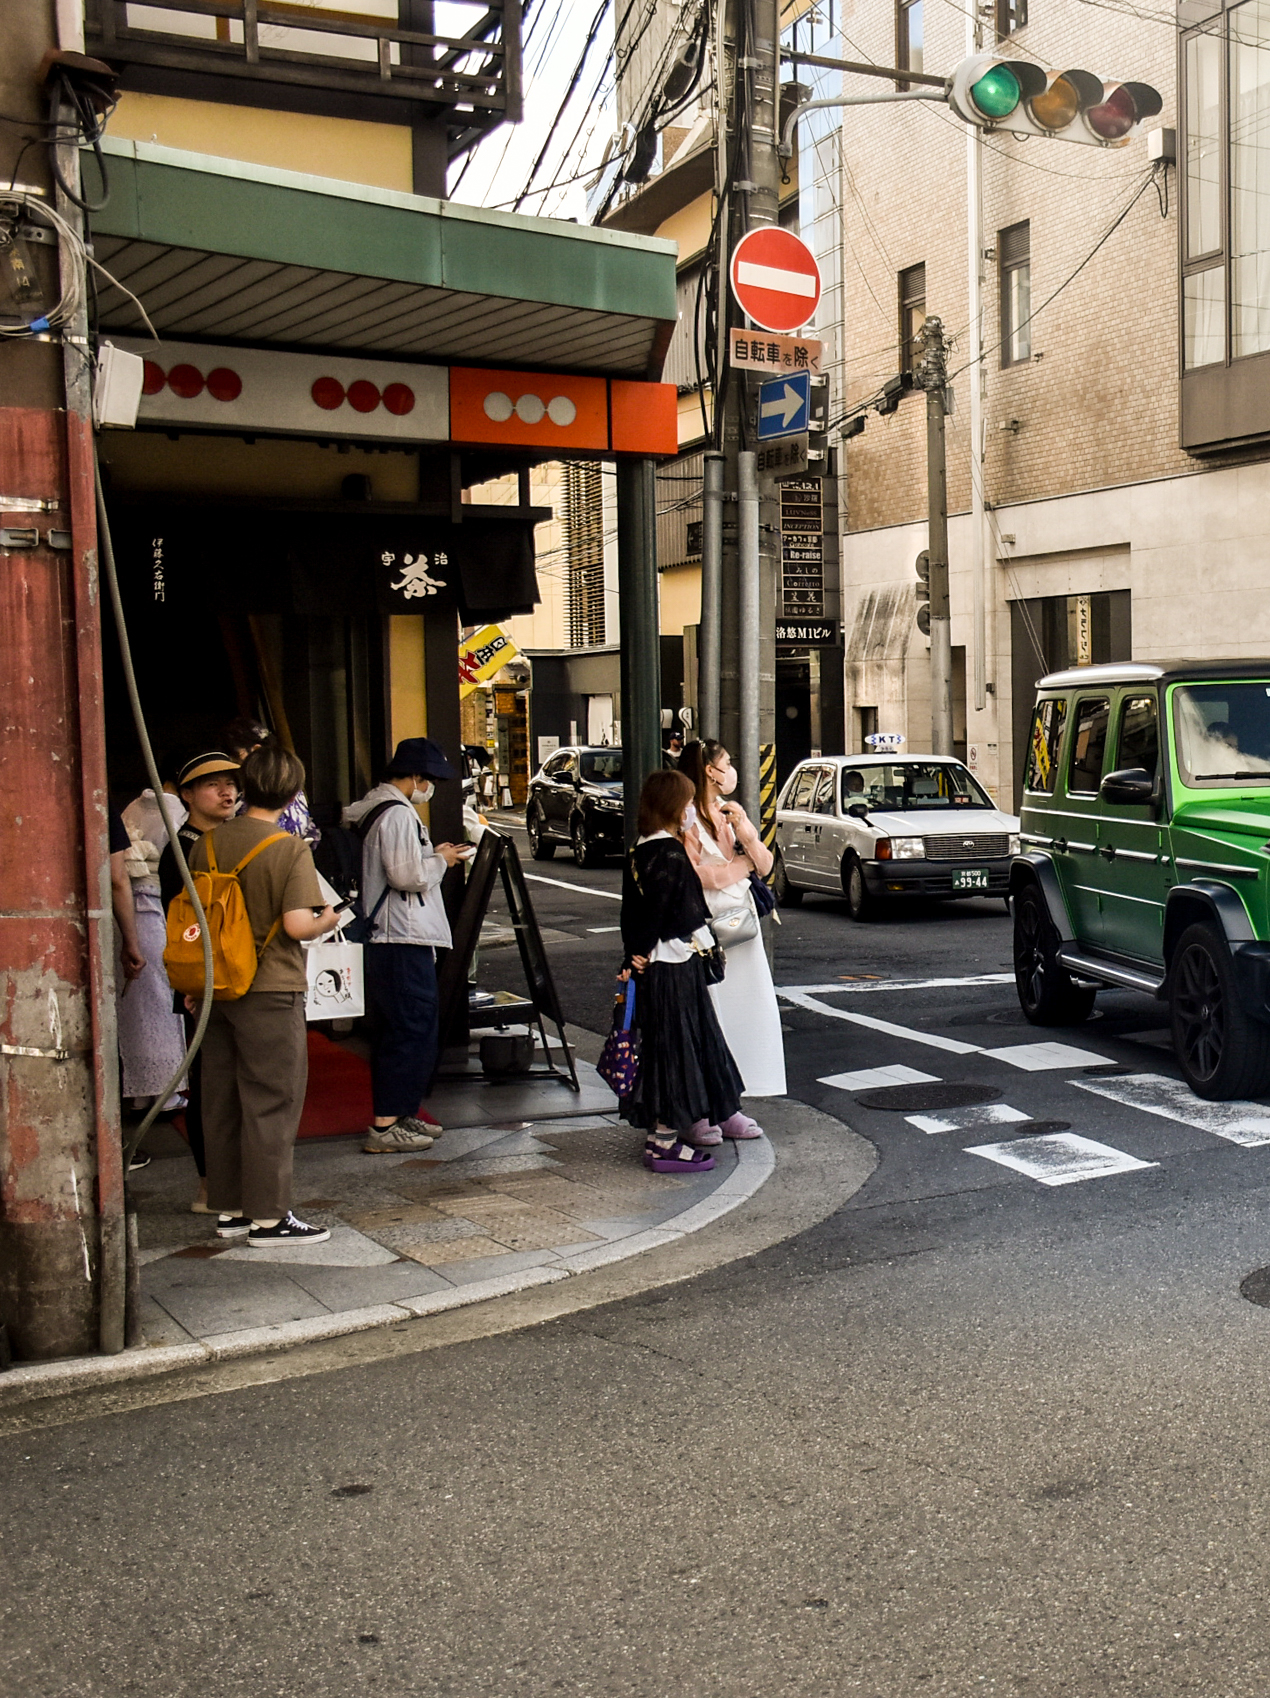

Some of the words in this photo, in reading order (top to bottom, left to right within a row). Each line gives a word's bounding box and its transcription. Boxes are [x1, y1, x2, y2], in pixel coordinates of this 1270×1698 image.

[735, 339, 819, 369] 自転車を除く
[152, 538, 165, 602] 伊藤久右衛門
[790, 550, 821, 560] Re-raise
[390, 553, 447, 599] 茶
[960, 876, 987, 888] 99-44
